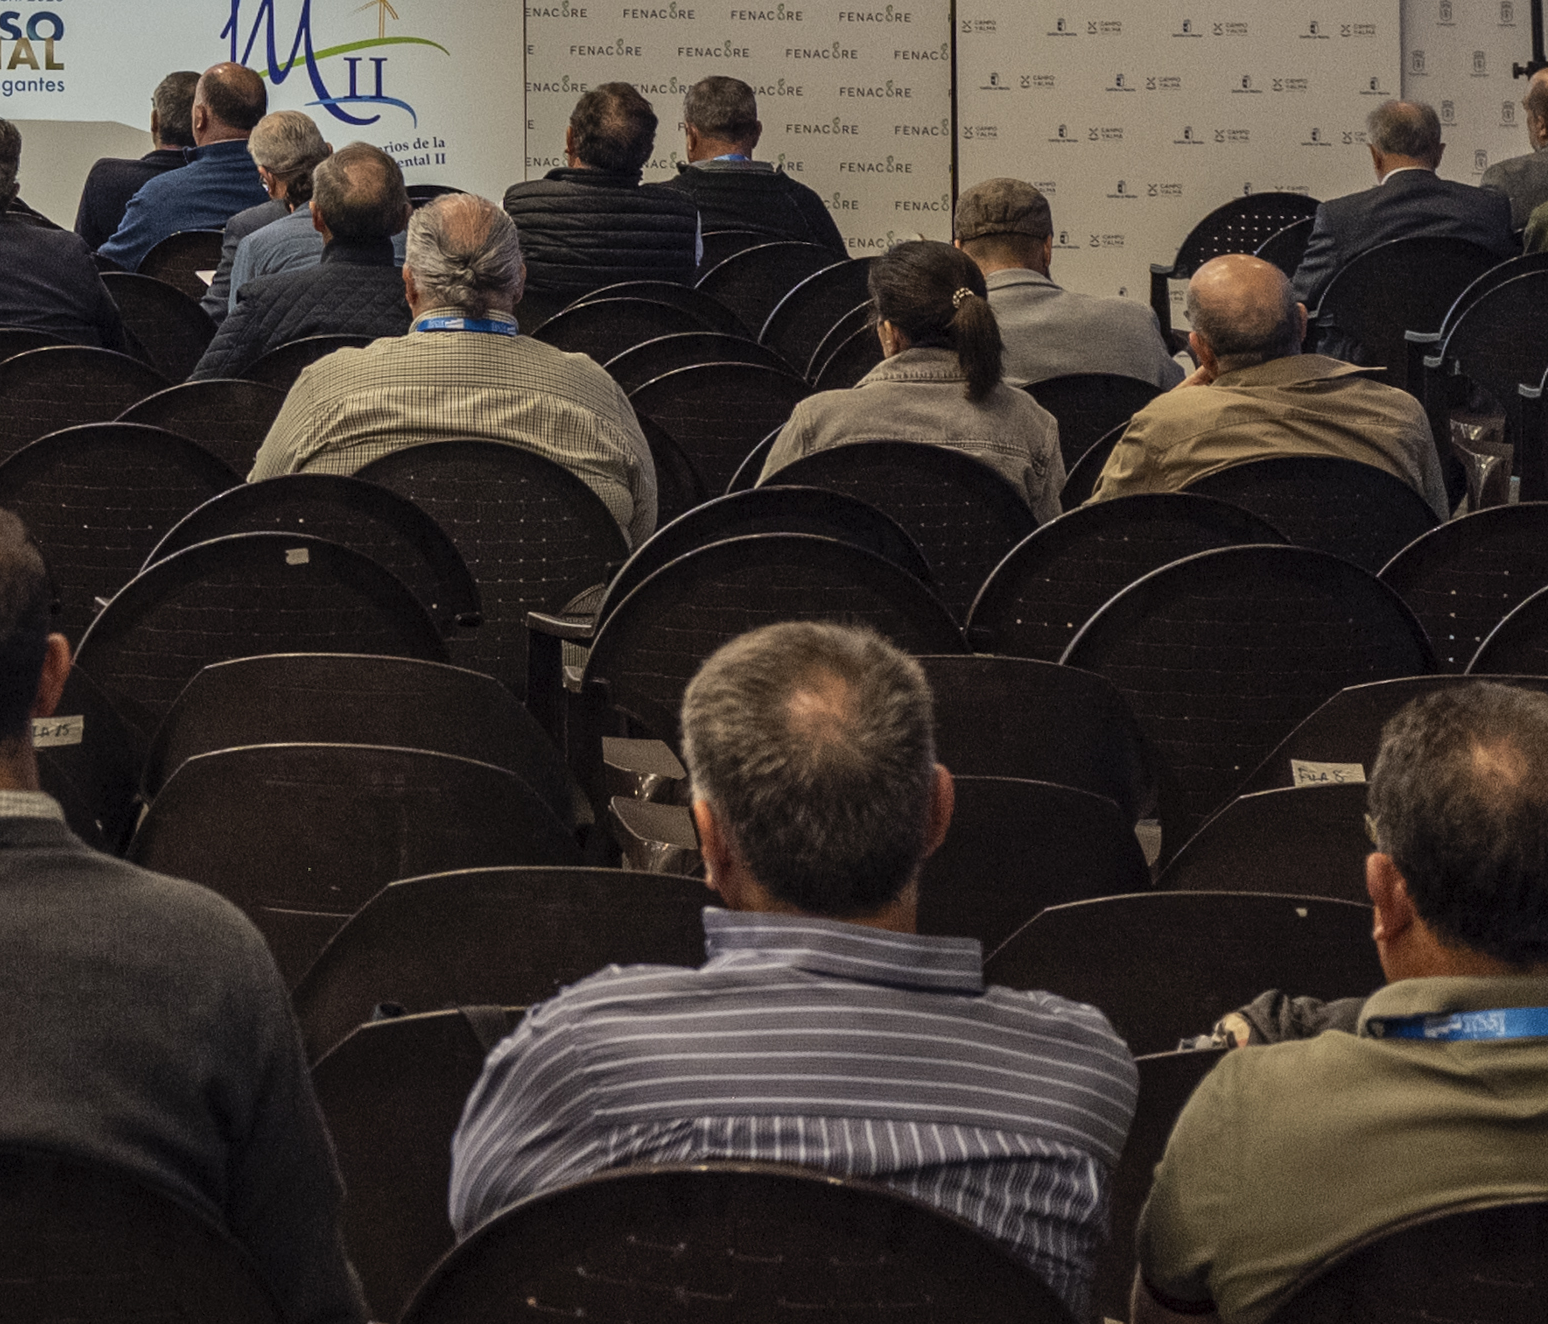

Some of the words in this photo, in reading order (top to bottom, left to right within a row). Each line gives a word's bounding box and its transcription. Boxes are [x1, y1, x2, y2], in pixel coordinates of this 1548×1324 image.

[786, 120, 859, 135] FENACORE
[413, 138, 429, 150] de
[433, 137, 446, 149] la
